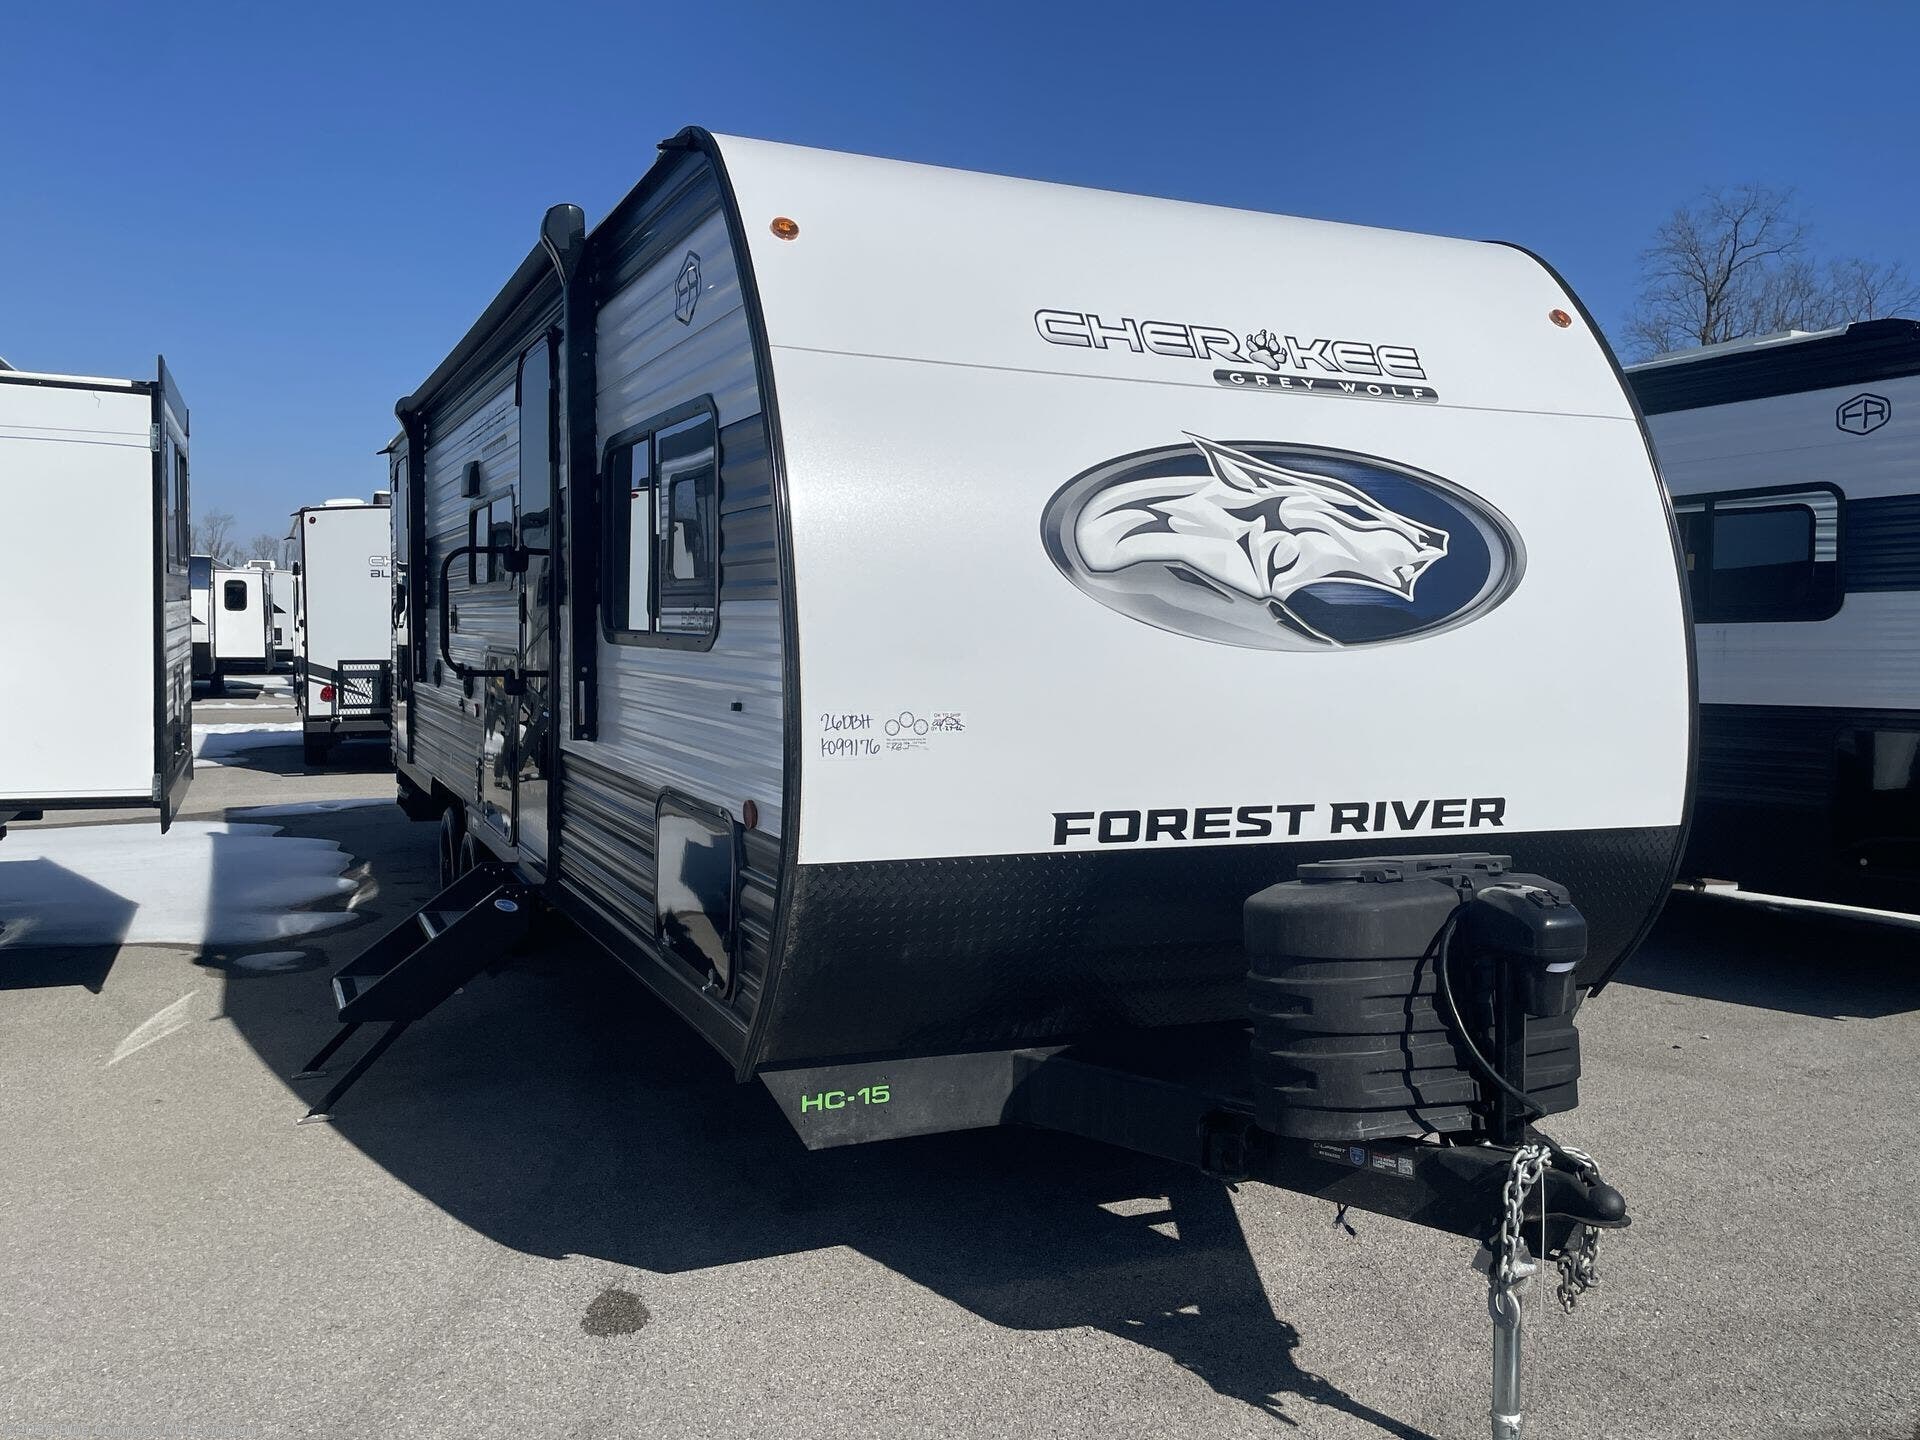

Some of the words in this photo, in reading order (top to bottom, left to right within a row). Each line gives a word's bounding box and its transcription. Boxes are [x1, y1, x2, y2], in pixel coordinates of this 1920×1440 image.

[1228, 372, 1318, 391] GREY
[1338, 381, 1427, 400] WOLF
[820, 713, 874, 732] 26DBH
[820, 737, 881, 758] K099176
[1051, 803, 1315, 846] FOREST
[1329, 796, 1507, 834] RIVER
[801, 1084, 891, 1113] HC-15
